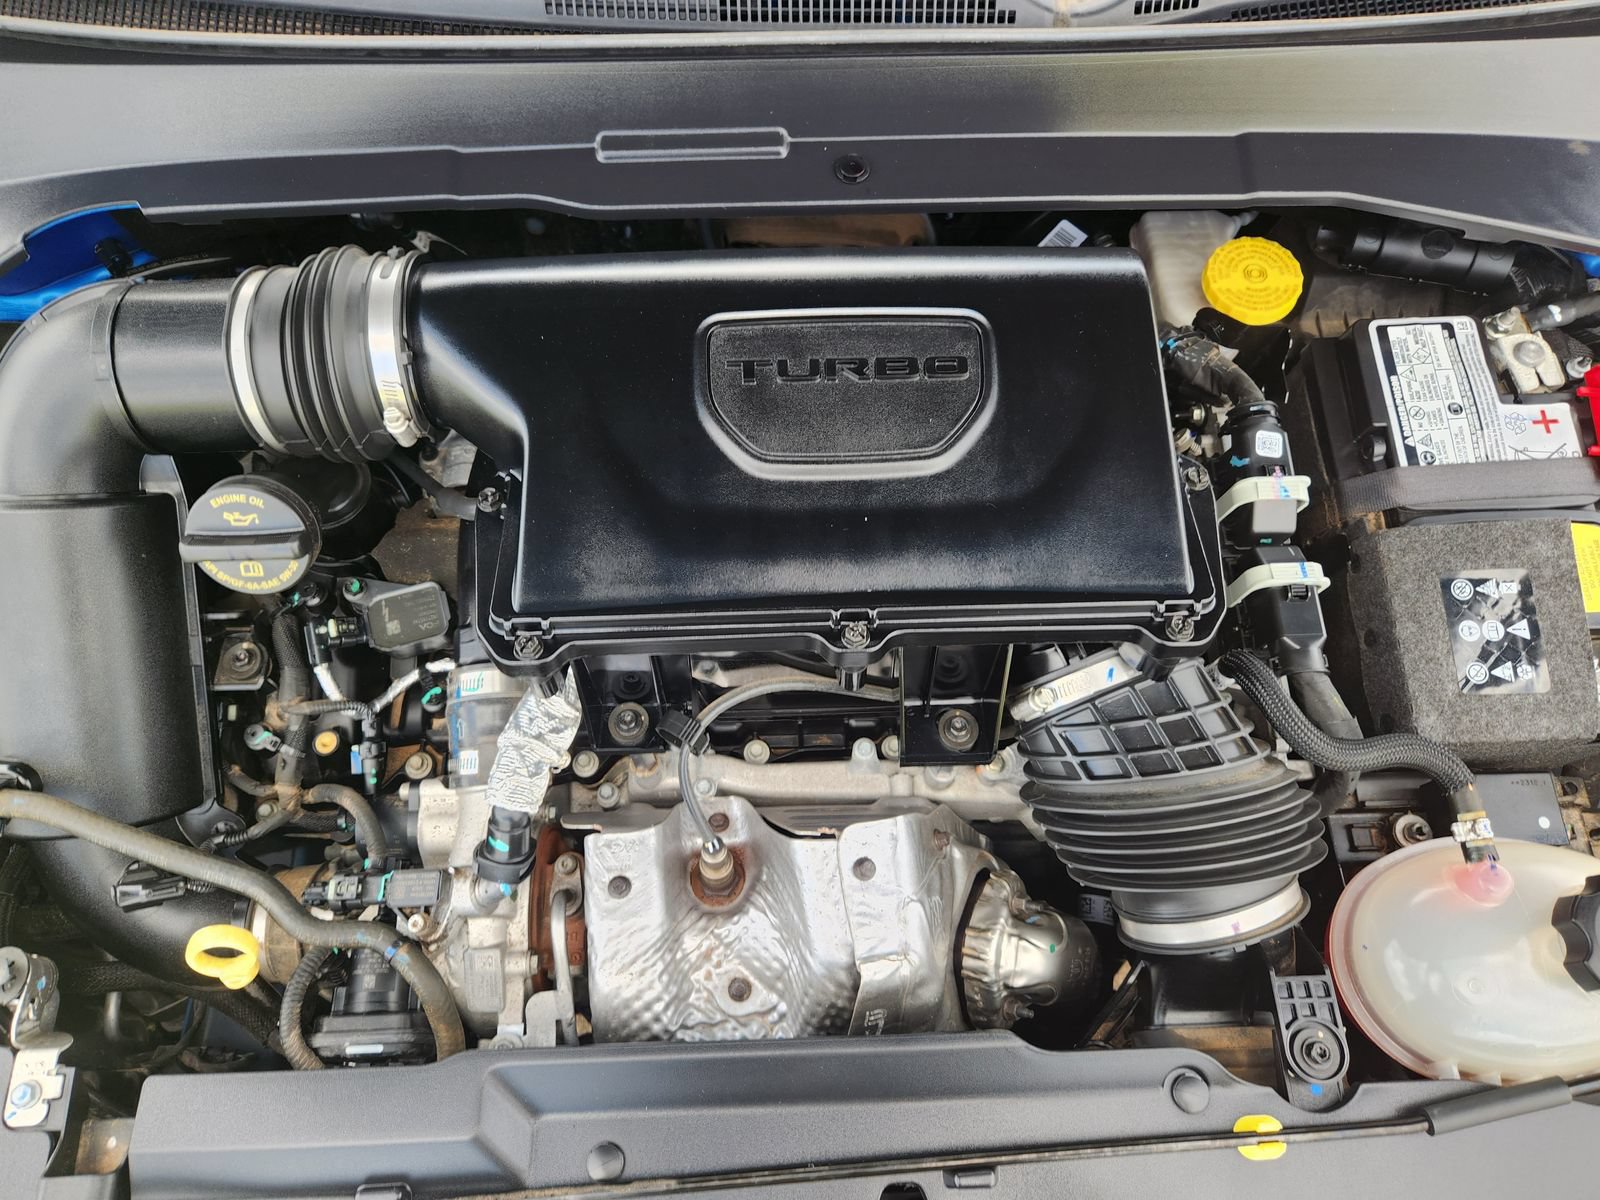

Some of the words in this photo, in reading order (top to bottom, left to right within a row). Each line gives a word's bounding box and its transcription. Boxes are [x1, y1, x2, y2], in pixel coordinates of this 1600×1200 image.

[725, 356, 970, 386] TURBO
[209, 493, 247, 509] ENGINE
[248, 495, 265, 509] OIL
